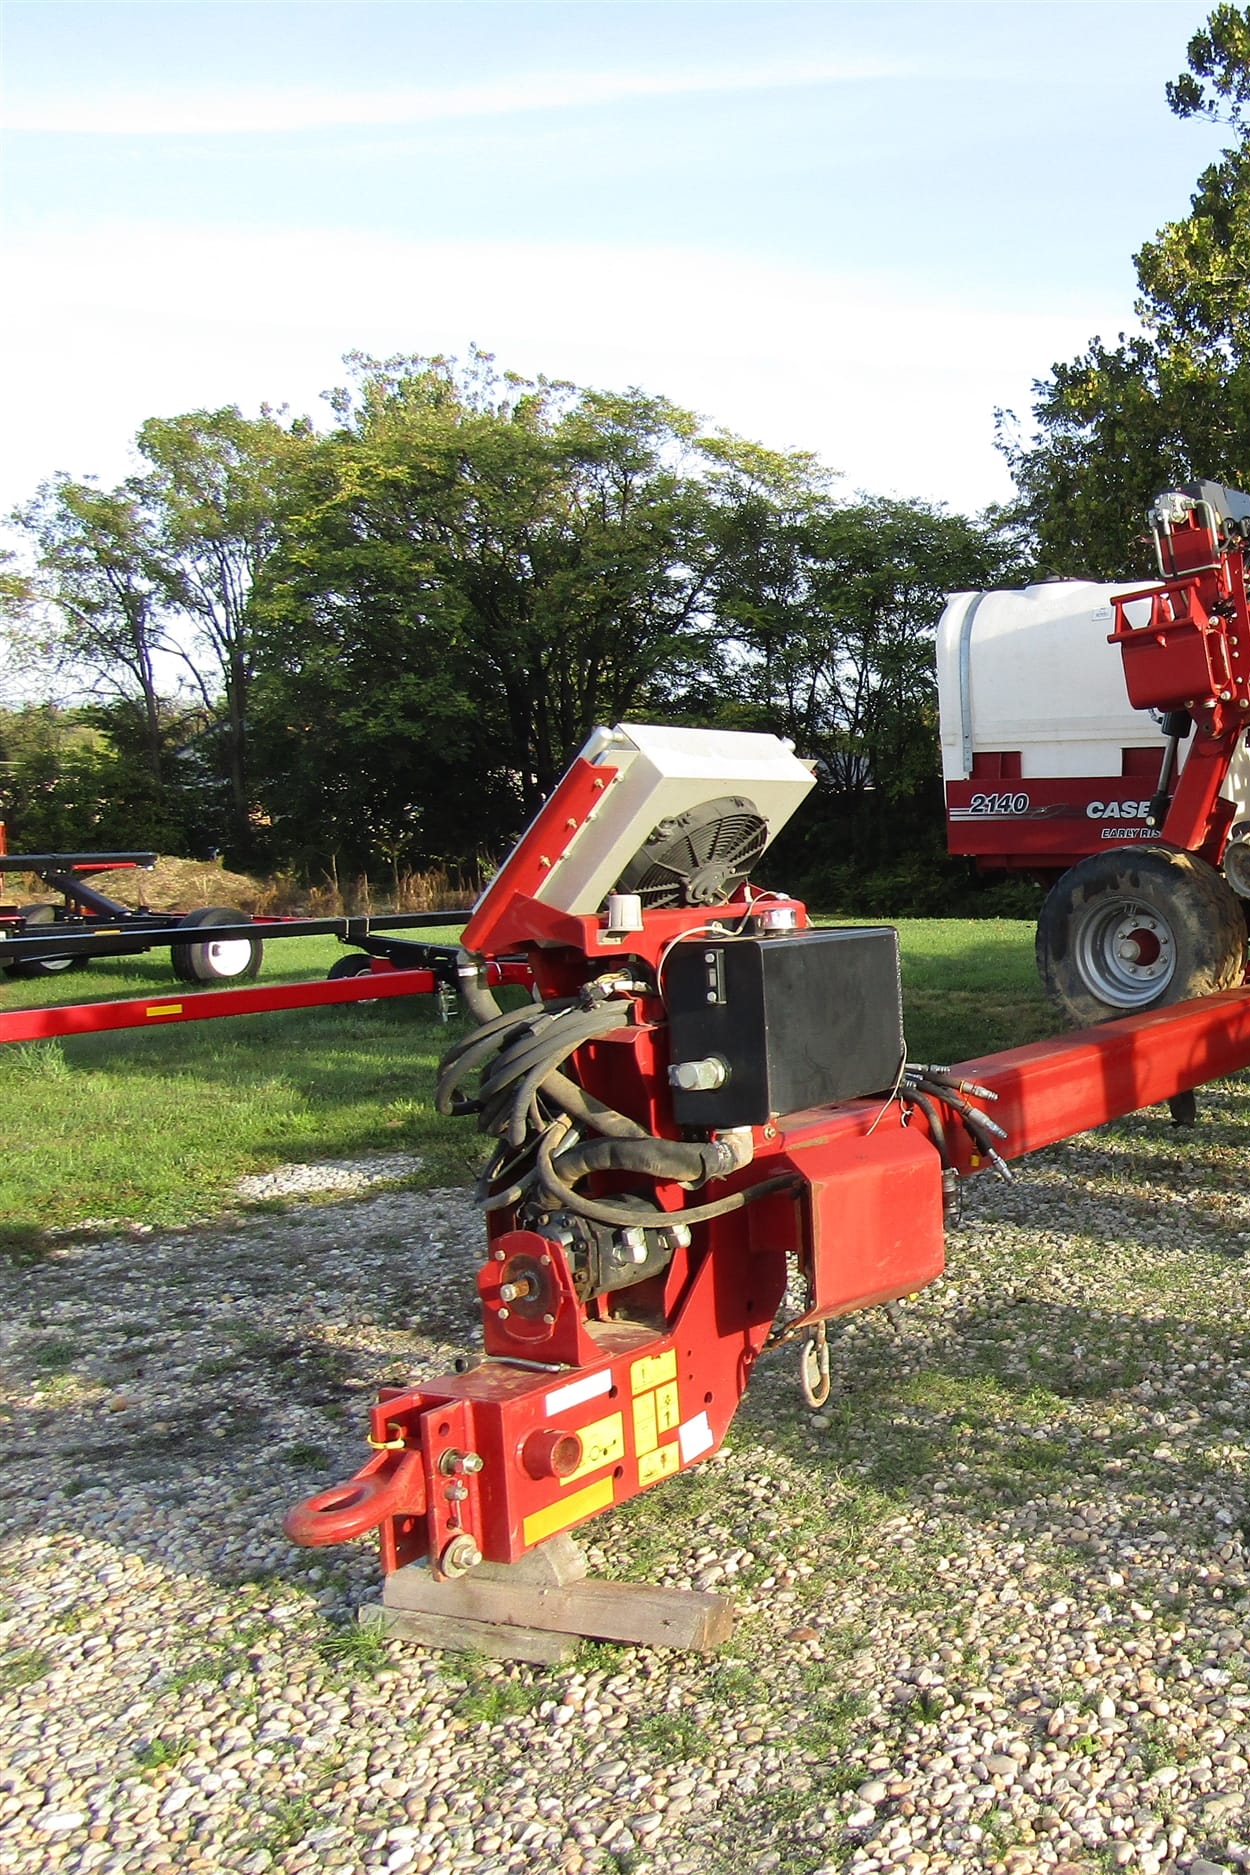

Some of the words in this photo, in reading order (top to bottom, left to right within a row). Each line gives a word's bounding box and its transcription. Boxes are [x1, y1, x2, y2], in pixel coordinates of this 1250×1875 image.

[969, 793, 1029, 814] 2140
[1086, 801, 1151, 819] CASE
[1101, 828, 1140, 839] EARLY
